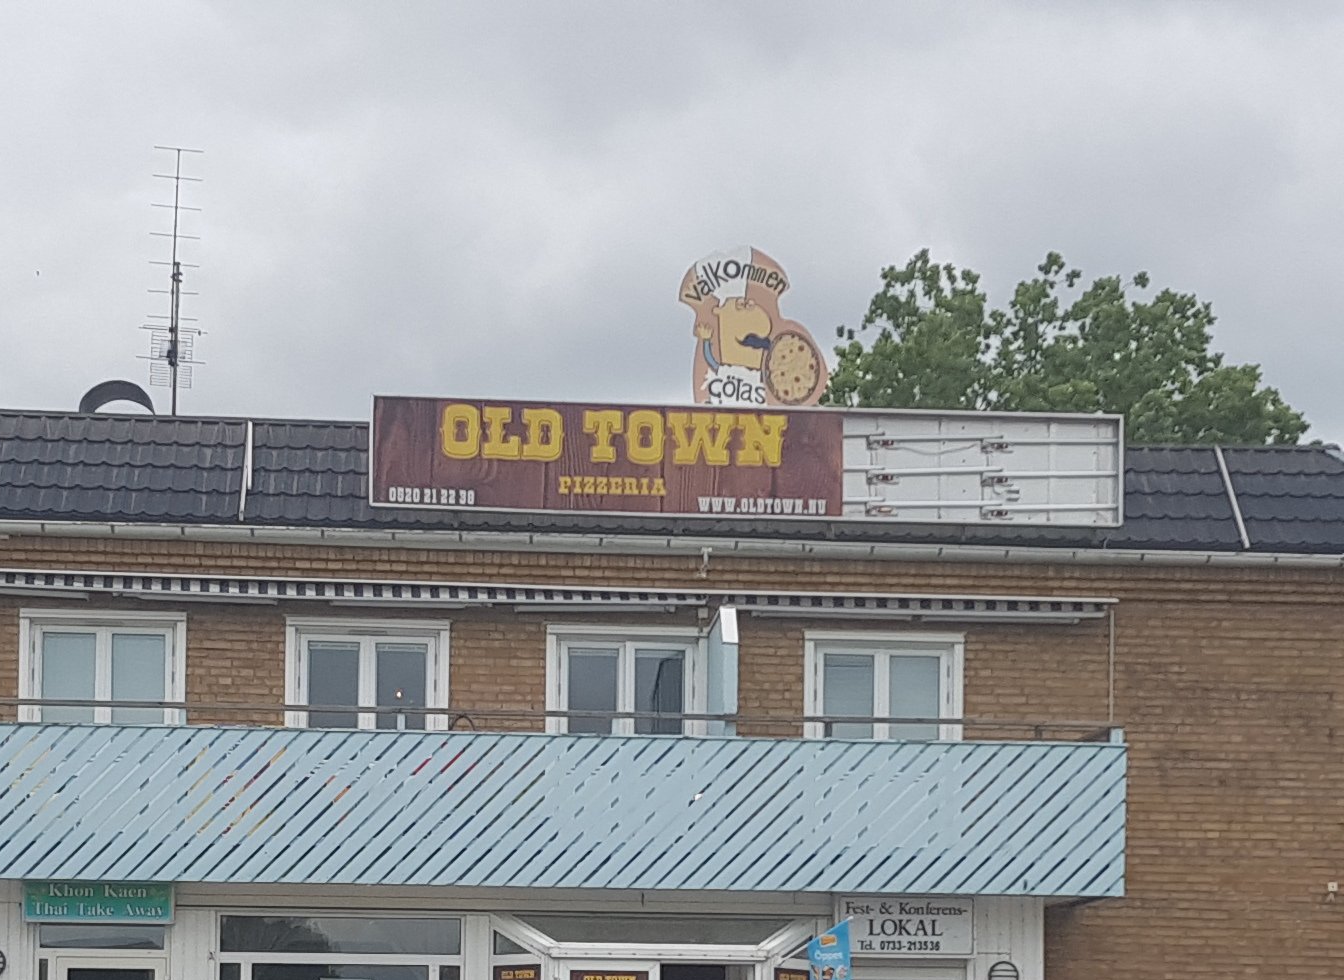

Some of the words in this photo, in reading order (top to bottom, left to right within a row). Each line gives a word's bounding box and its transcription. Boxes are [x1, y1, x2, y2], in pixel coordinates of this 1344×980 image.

[441, 404, 564, 460] OLD
[584, 410, 788, 466] TOWN
[558, 476, 666, 496] PIZZERIA
[389, 487, 420, 503] 0520
[424, 488, 436, 504] 21
[441, 488, 456, 504] 22
[698, 496, 827, 515] WWW.OLDTOWN.NU
[49, 883, 94, 897] Khon
[104, 884, 147, 898] Kaen
[33, 902, 68, 916] Thai
[76, 902, 114, 916] Take
[124, 903, 164, 919] Away
[845, 901, 875, 915] Fest-
[879, 902, 894, 915] &
[899, 902, 968, 916] Konferens-
[868, 919, 944, 937] LOKAL
